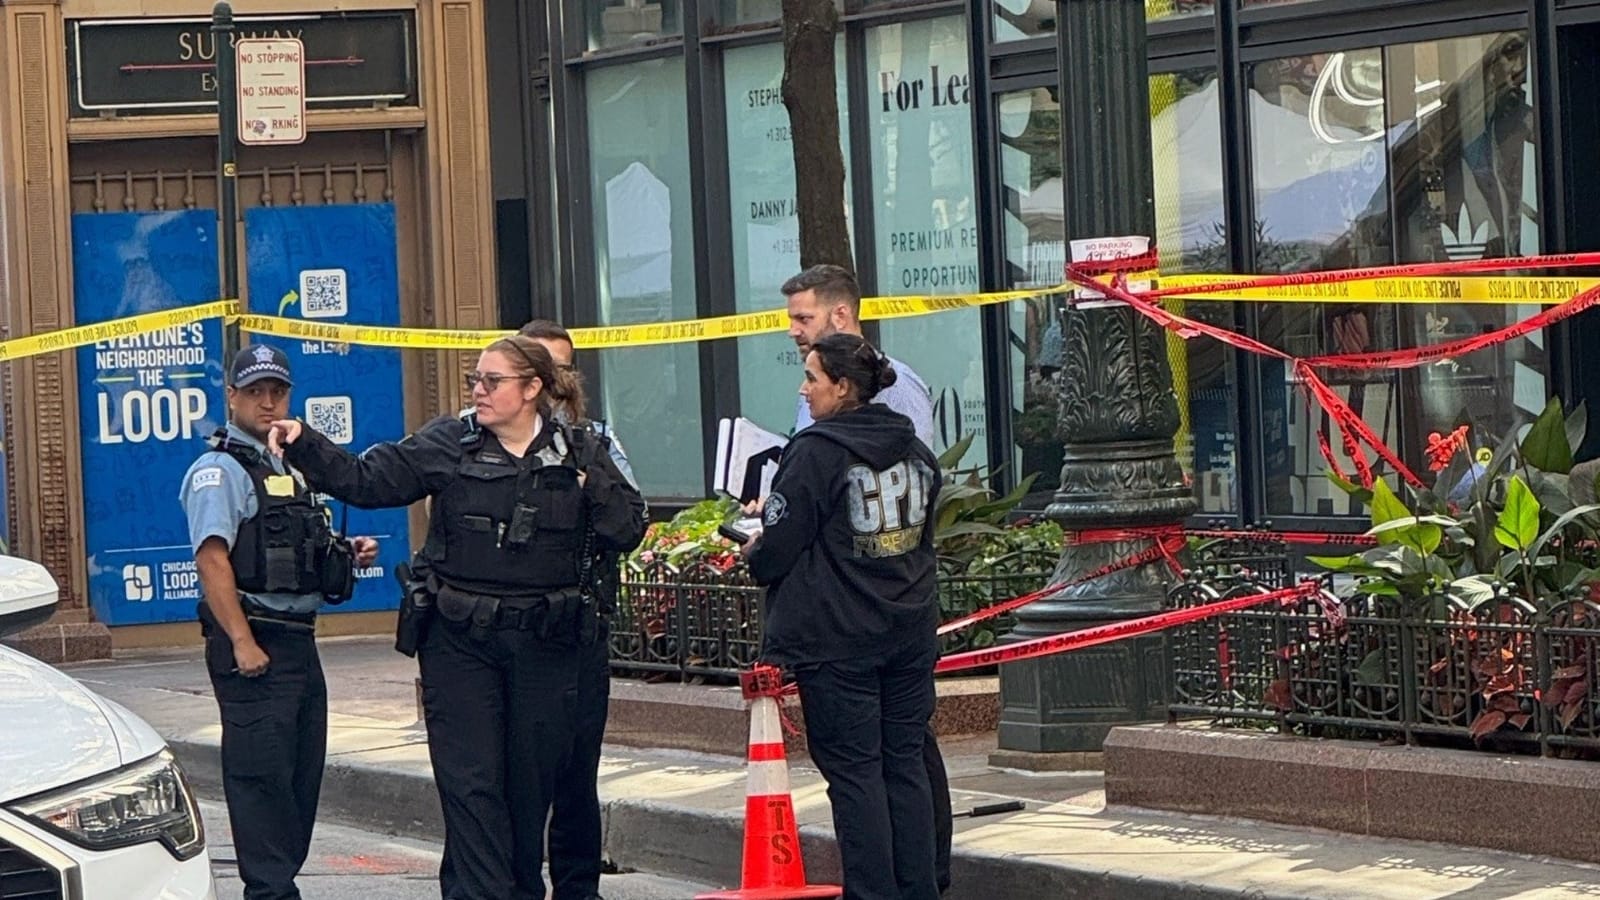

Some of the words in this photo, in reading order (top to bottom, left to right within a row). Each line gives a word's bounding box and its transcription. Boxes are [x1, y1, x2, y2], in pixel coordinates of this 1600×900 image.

[241, 55, 253, 64] NO
[257, 52, 299, 64] STOPPING
[243, 88, 255, 97] NO
[258, 85, 299, 97] STANDING
[881, 72, 924, 112] For
[750, 199, 785, 220] DANNY
[891, 230, 953, 253] PREMIUM
[902, 267, 977, 289] OPPORTUN
[1438, 281, 1461, 298] POLICE
[301, 341, 320, 356] the
[96, 347, 205, 370] NEIGHBORHOOD
[138, 369, 164, 387] THE
[97, 387, 208, 445] LOOP
[163, 573, 199, 588] LOOP
